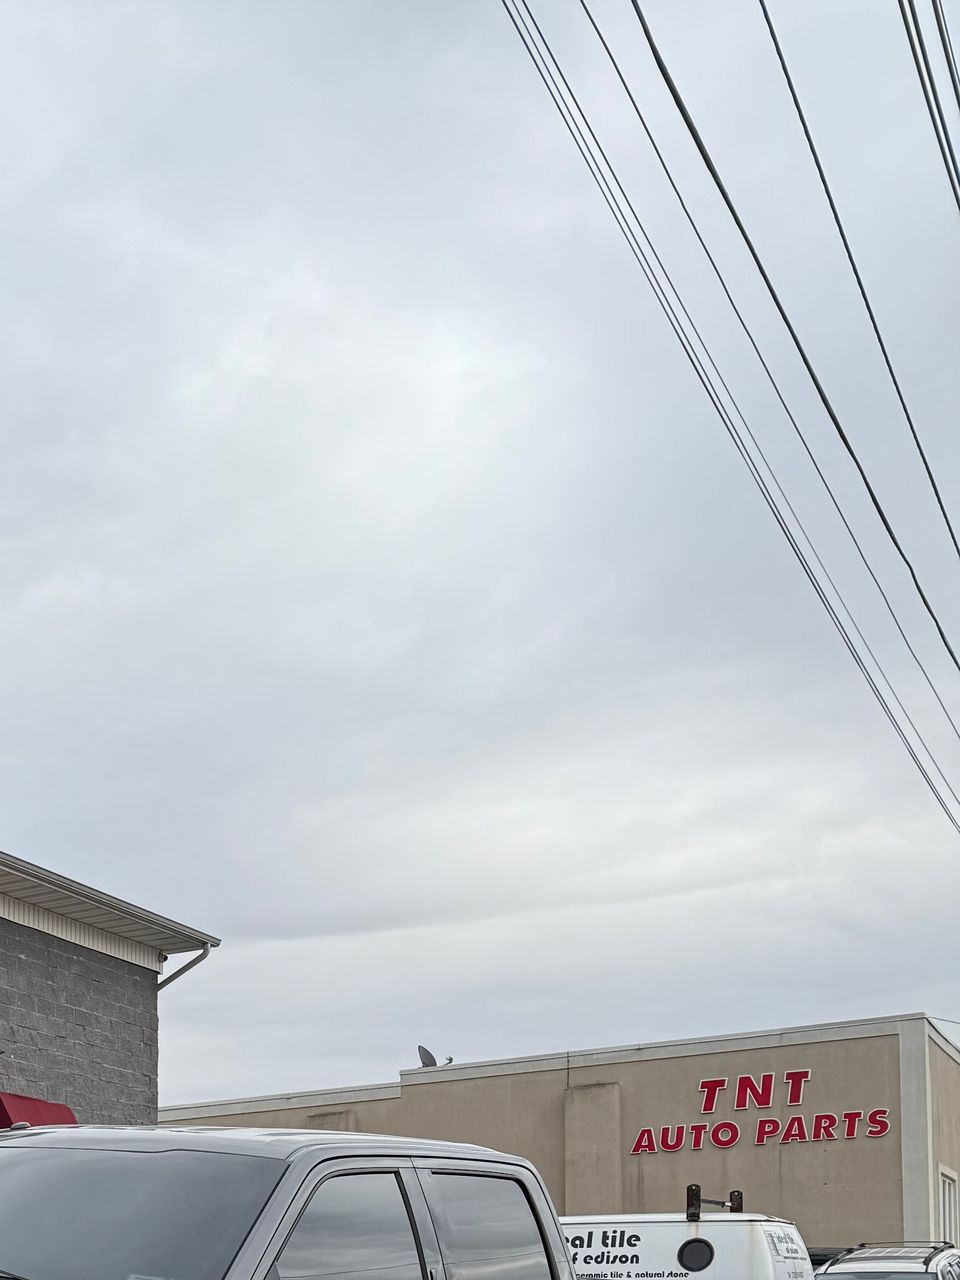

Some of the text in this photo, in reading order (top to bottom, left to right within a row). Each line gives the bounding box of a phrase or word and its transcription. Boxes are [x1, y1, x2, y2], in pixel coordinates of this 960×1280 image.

[698, 1069, 811, 1114] TNT
[630, 1108, 891, 1154] AUTO PARTS
[601, 1229, 641, 1248] tile
[583, 1251, 640, 1265] edison
[610, 1270, 624, 1279] tile
[626, 1271, 632, 1279] &
[634, 1270, 665, 1279] natural
[667, 1270, 690, 1279] stone
